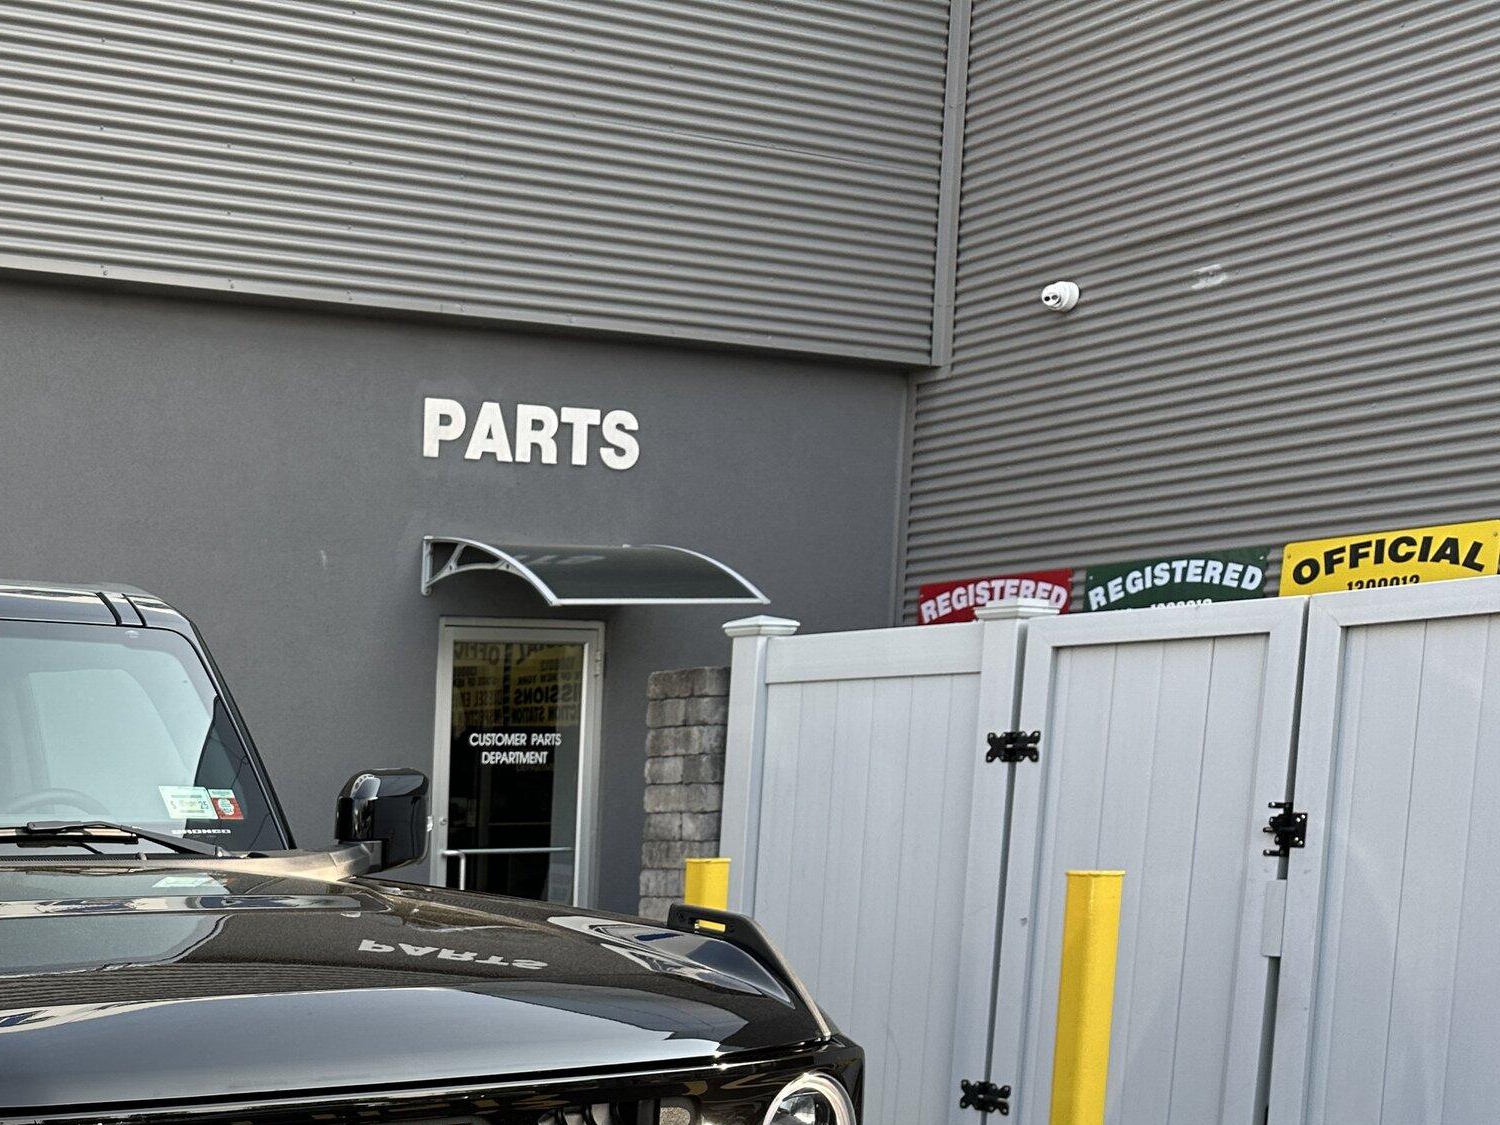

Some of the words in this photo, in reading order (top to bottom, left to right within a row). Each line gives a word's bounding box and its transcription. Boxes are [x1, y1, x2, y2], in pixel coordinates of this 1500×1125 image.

[422, 397, 641, 471] PARTS
[1292, 536, 1485, 585] OFFICIAL
[920, 578, 1068, 624] REGISTERED
[1088, 559, 1263, 610] REGISTERED
[469, 733, 527, 746] CUSTOMER
[531, 733, 562, 746] PARTS
[481, 751, 548, 764] DEPARTMENT
